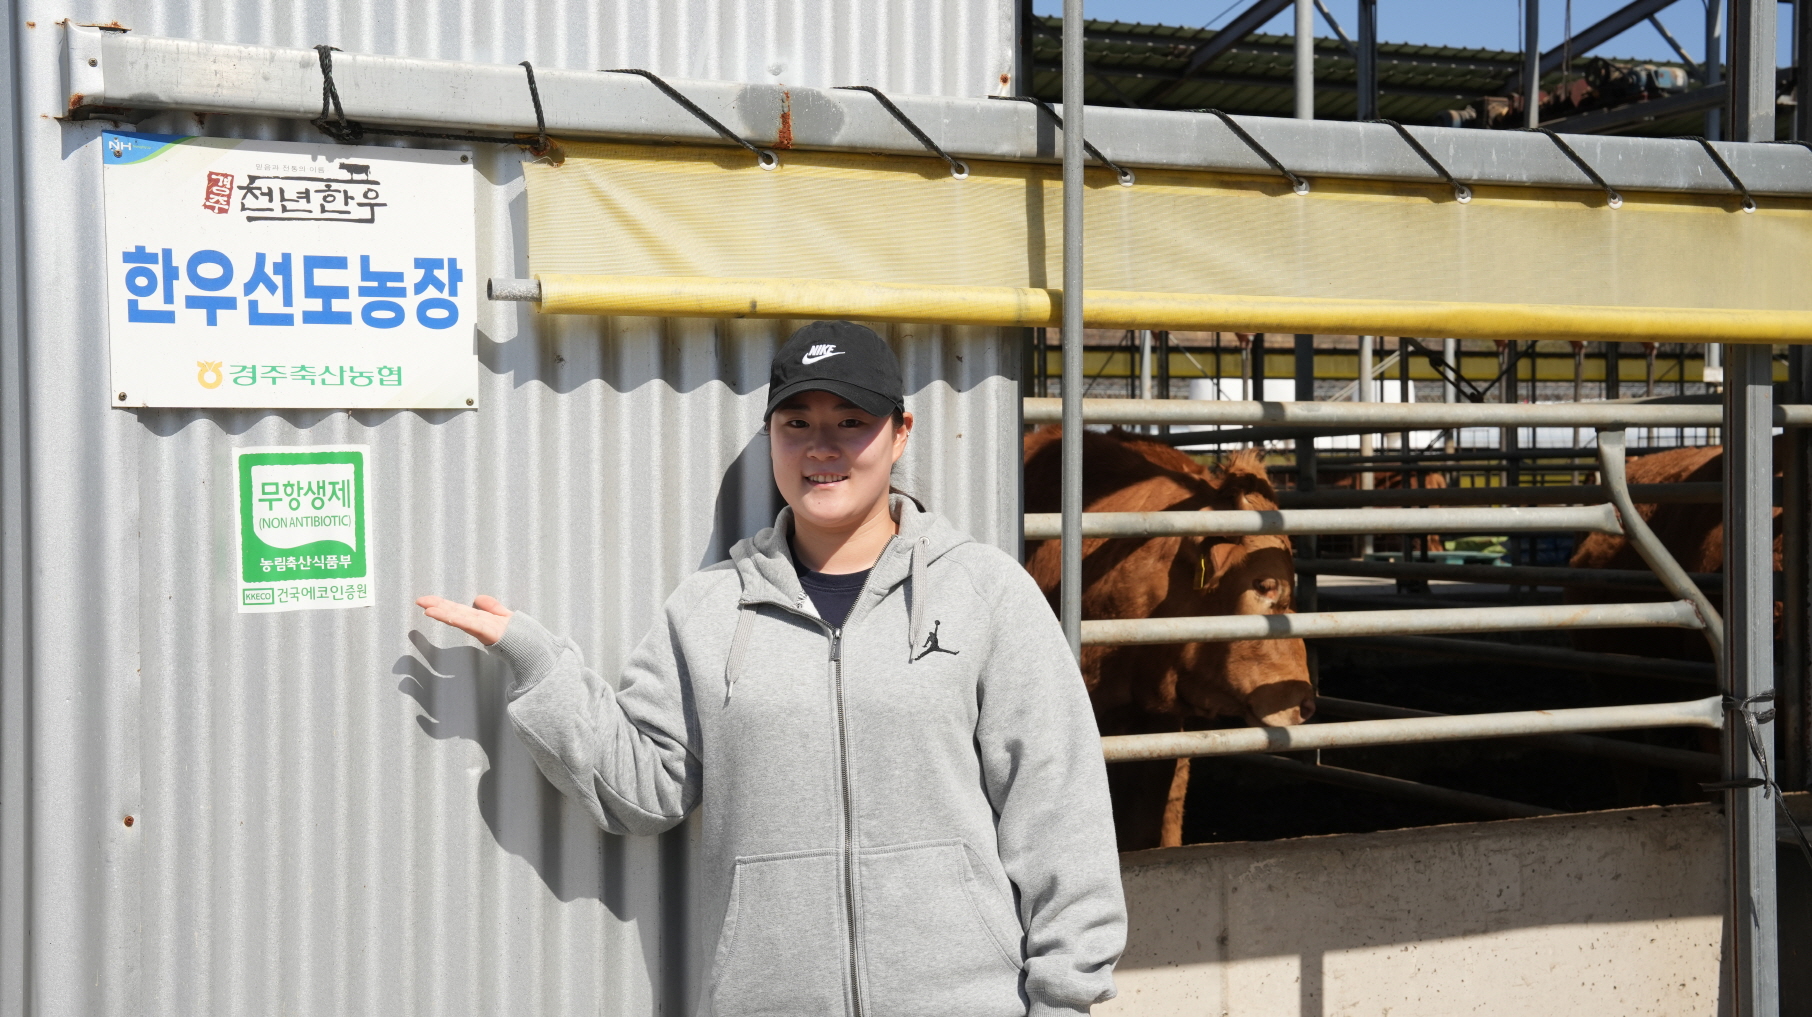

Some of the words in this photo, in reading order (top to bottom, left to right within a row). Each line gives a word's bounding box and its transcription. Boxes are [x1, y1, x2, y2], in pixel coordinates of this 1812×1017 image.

[108, 141, 132, 151] NH
[255, 163, 279, 171] 믿음과
[282, 164, 306, 173] 전통의
[309, 166, 325, 174] 이름
[205, 174, 232, 214] 경주
[237, 176, 388, 223] 천년한우
[122, 245, 463, 330] 한우선도농장
[808, 344, 836, 356] NIKE
[229, 364, 403, 387] 경주축산농협
[258, 479, 351, 511] 무항생제
[259, 517, 287, 530] (NON
[289, 515, 352, 529] ANTIBIOTIC)
[260, 554, 352, 573] 농림축산식품부
[245, 592, 272, 601] KKECO
[277, 583, 368, 603] 건국에코인증원
